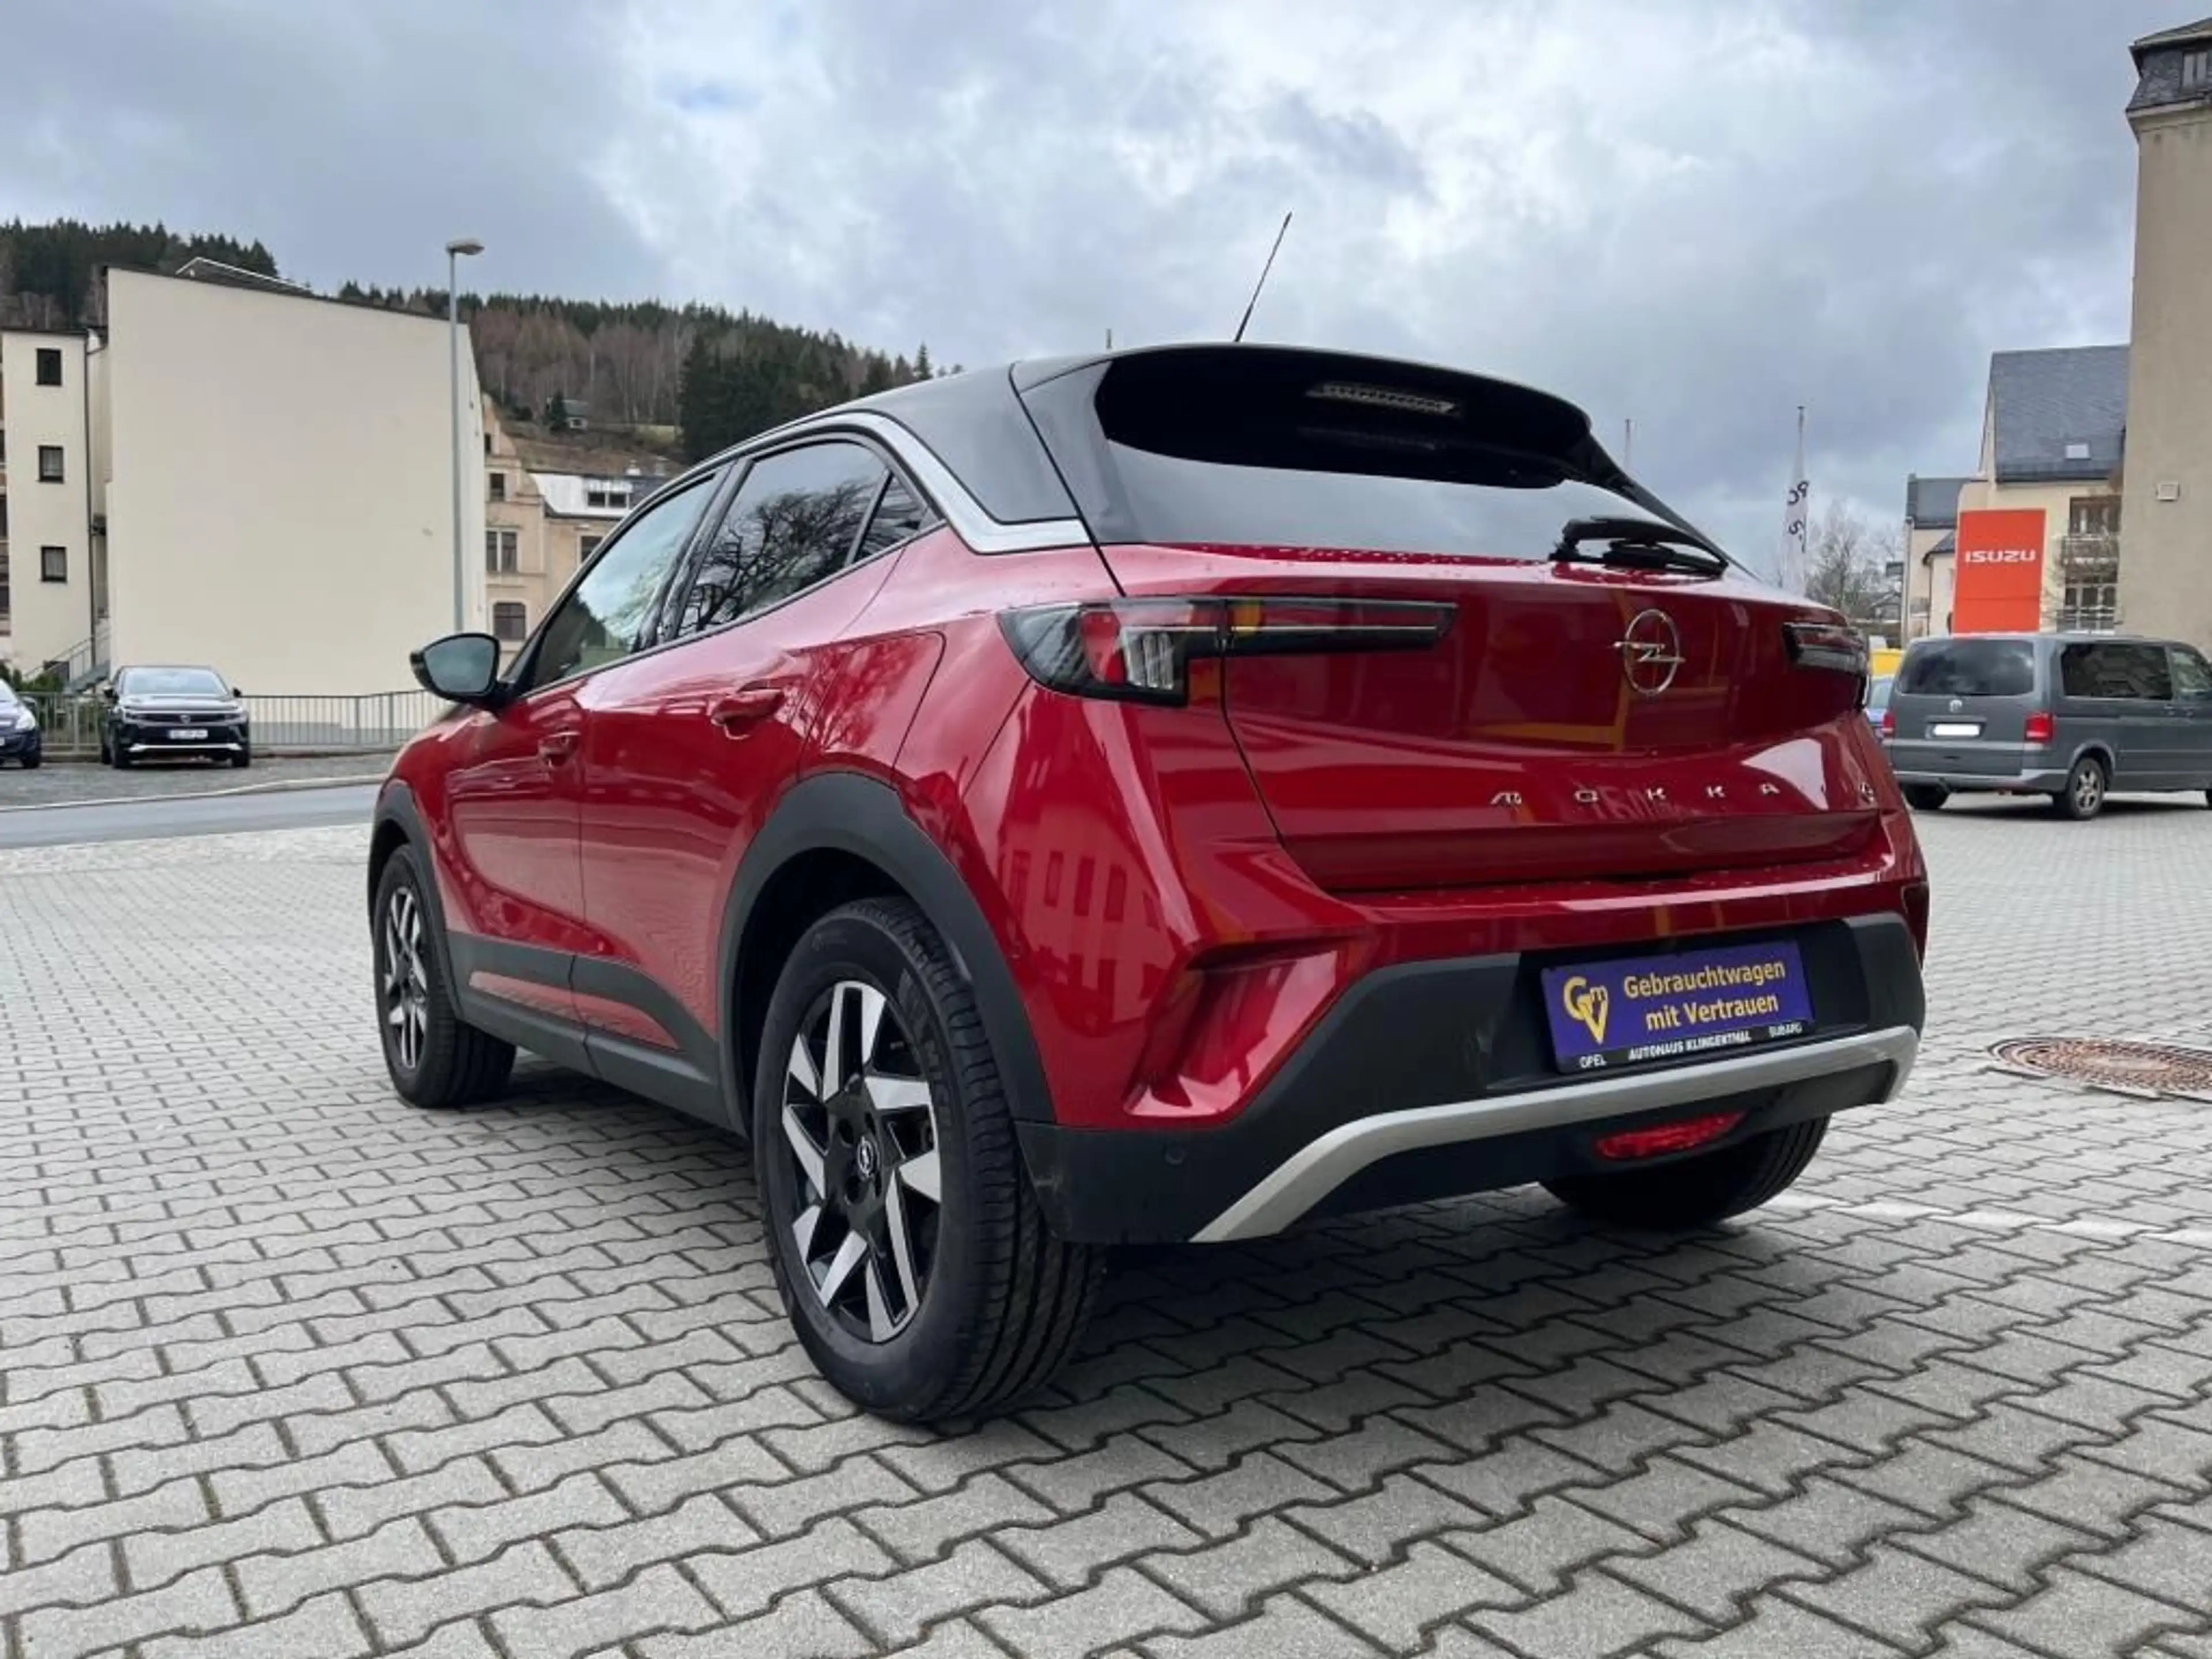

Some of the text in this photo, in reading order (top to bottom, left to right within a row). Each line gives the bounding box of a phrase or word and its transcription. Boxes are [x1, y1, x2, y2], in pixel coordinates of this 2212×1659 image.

[1965, 548, 2036, 563] ISUZU
[1624, 961, 1785, 998] Gebrauchtwagen
[1646, 994, 1778, 1031] mit Vertrauen
[1580, 1054, 1607, 1068] OPEL
[1628, 1041, 1684, 1060] AUTOHAUS
